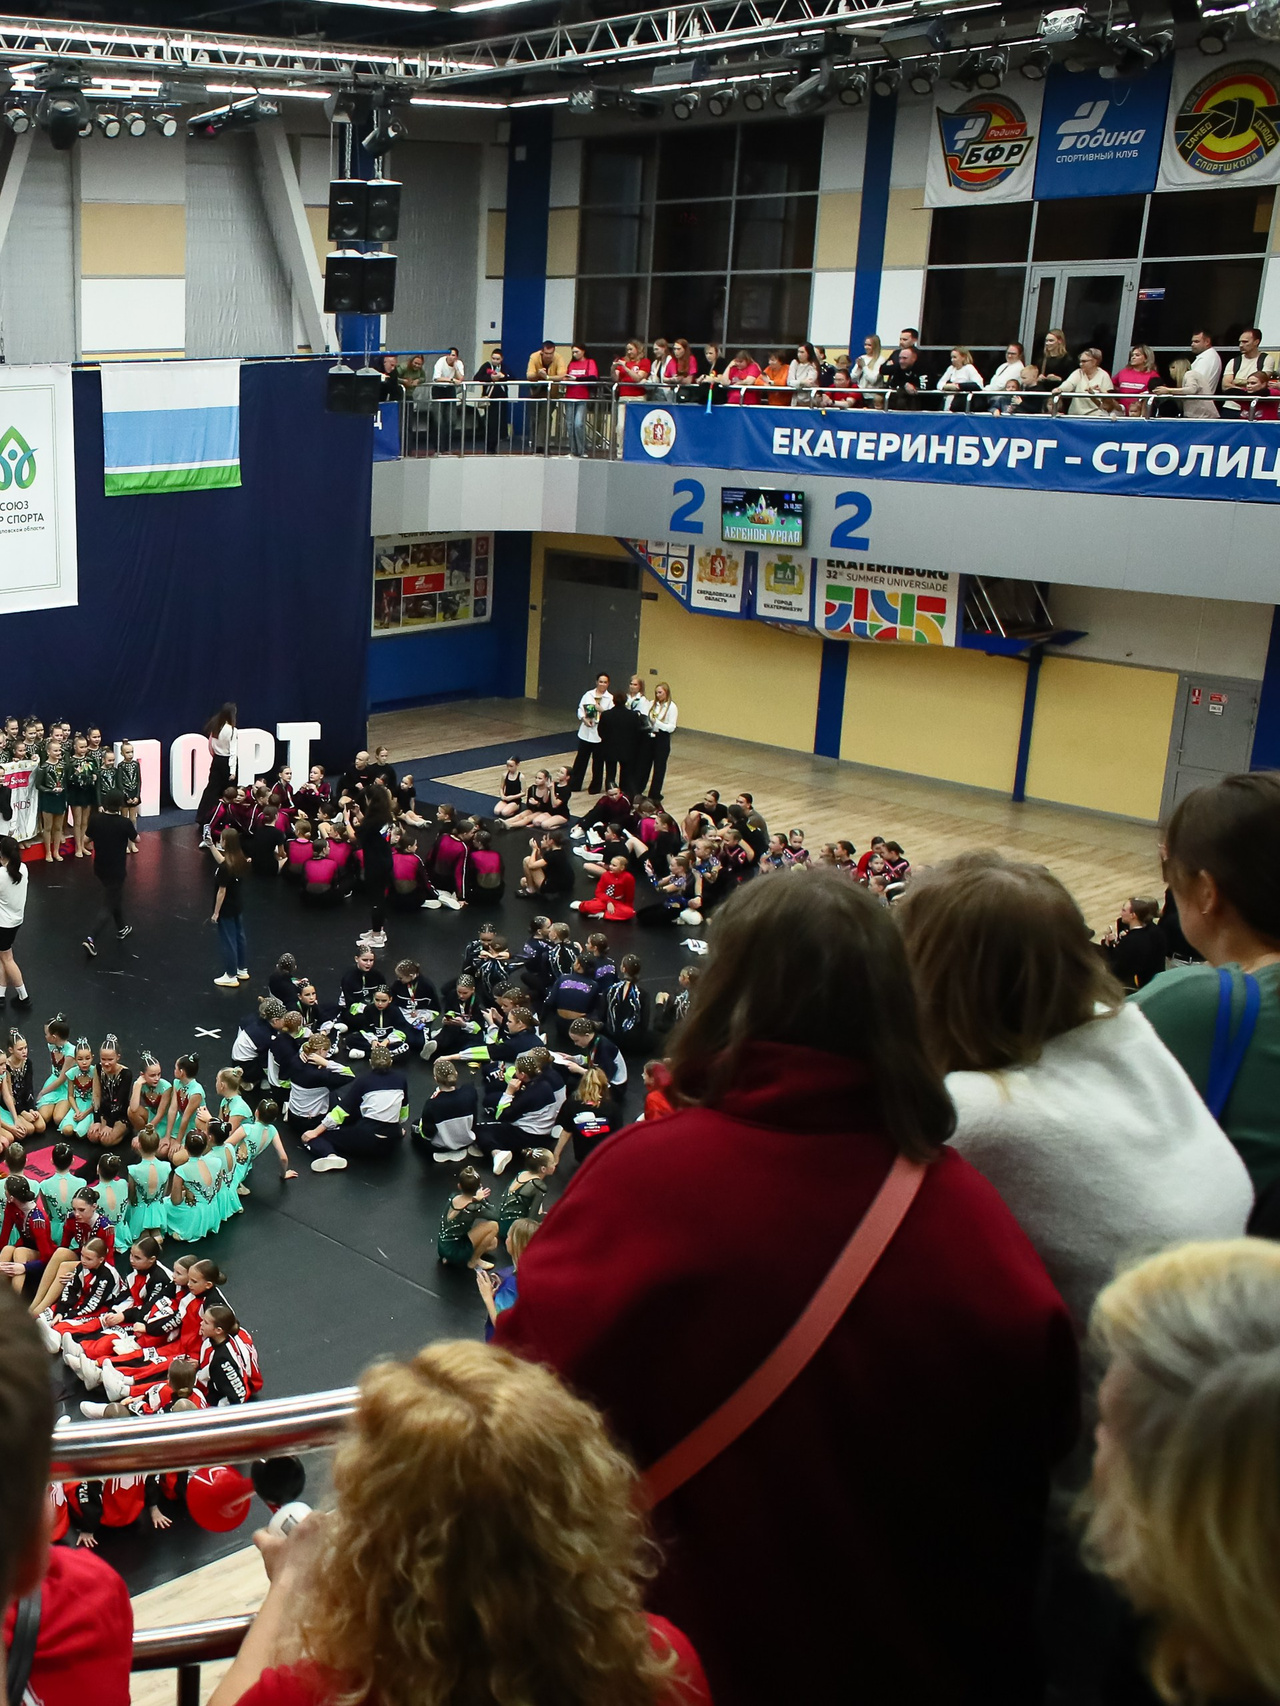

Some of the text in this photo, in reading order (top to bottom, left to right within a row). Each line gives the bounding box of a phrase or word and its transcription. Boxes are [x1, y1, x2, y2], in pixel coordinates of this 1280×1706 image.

[1185, 121, 1213, 149] САМБО
[1253, 119, 1276, 147] ДЗЮДО
[964, 143, 1024, 166] БФР
[1056, 149, 1139, 163] СПОРТИВНЫЙ КЛУБ
[1194, 152, 1259, 172] СПОРТШКОЛА
[772, 426, 1058, 470] ЕКАТЕРИНБУРГ
[0, 500, 29, 512] СОЮЗ
[670, 478, 705, 534] 2
[6, 513, 44, 525] СПОРТА
[830, 491, 873, 551] 2
[724, 526, 801, 543] ЛЕГЕНДЫ УРАЛА
[846, 573, 885, 585] SUMMER
[887, 578, 948, 592] UNIVERSIADE
[113, 721, 321, 817] ПОРТ
